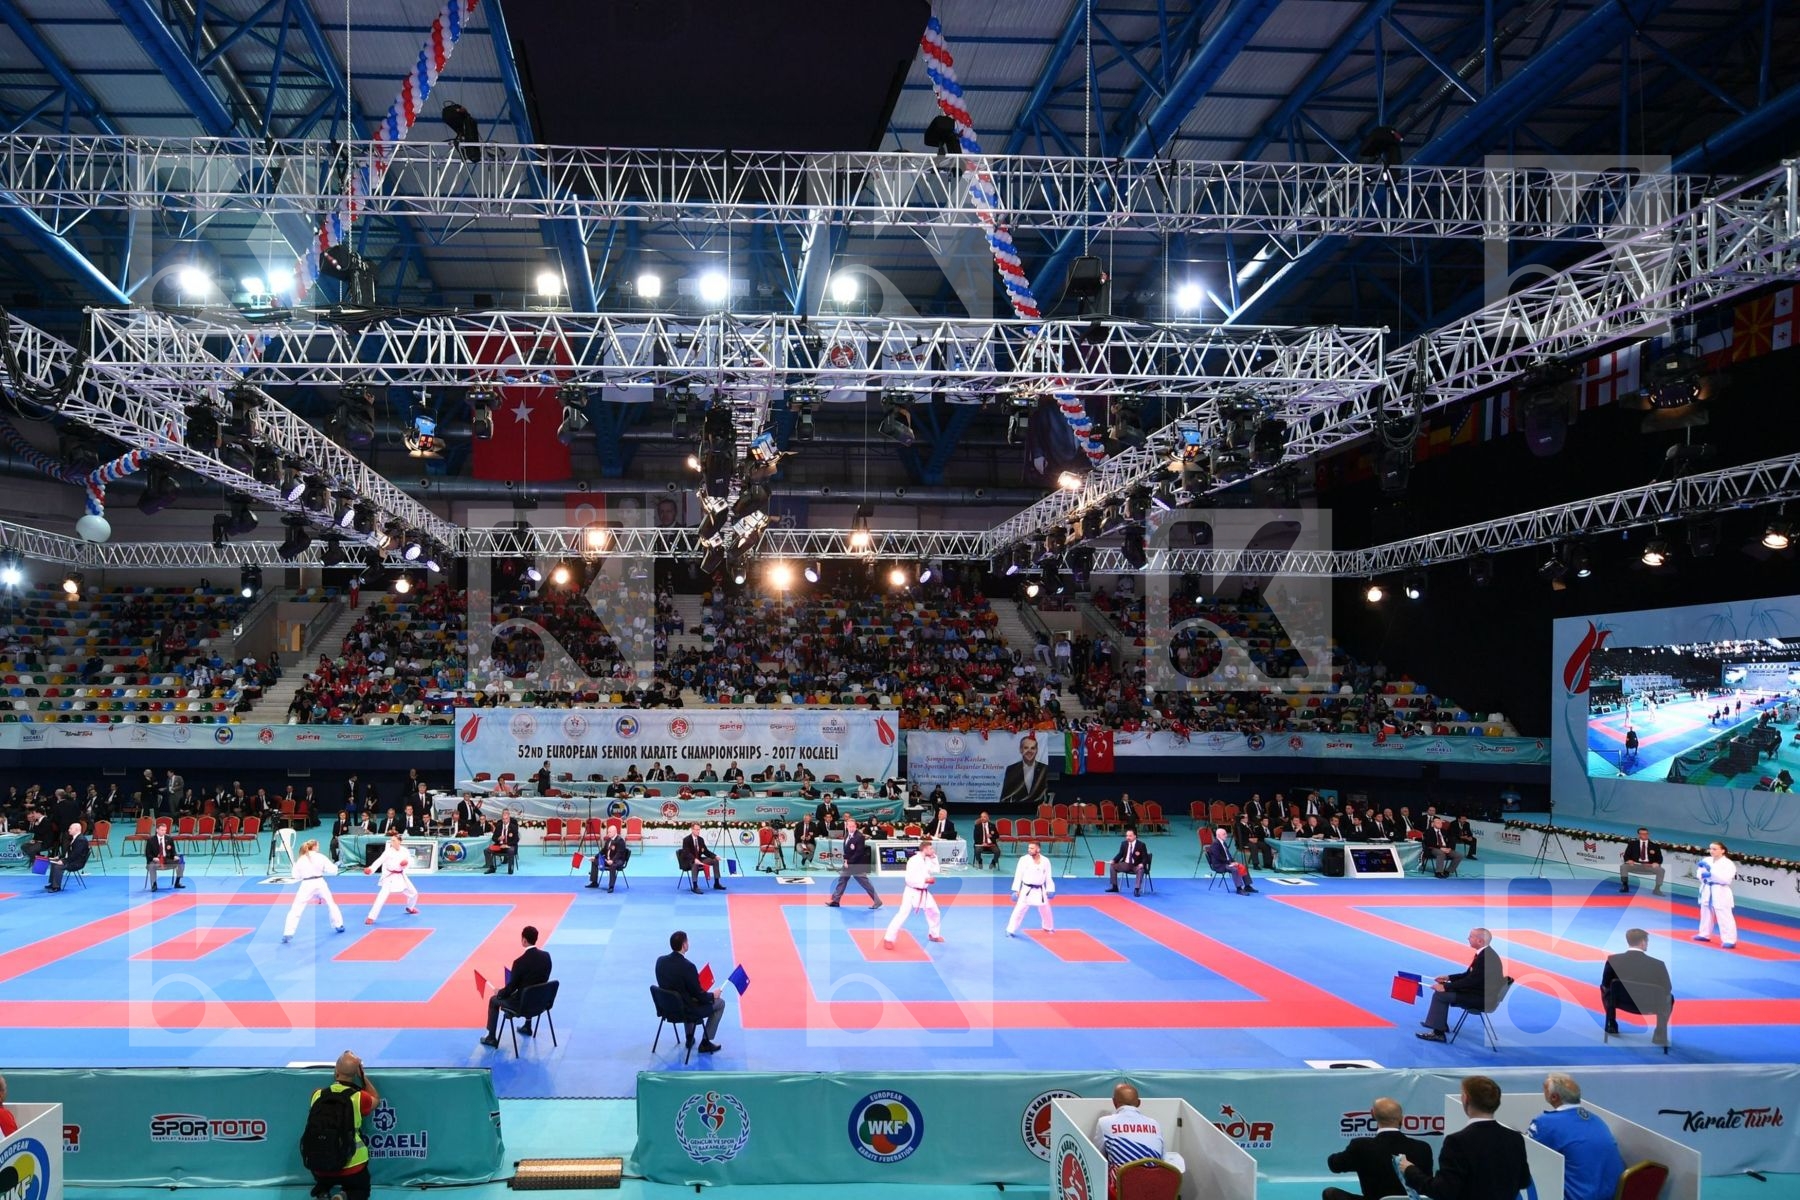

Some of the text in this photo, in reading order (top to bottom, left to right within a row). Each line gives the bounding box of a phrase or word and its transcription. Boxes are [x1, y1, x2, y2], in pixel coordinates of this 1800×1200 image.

[518, 745, 543, 758] 52ND
[546, 745, 598, 759] EUROPEAN
[601, 745, 637, 759] SENIOR
[641, 745, 678, 759] KARATE
[681, 745, 762, 760] CHAMPIONSHIPS
[772, 746, 795, 760] 2017
[799, 743, 839, 760] KOCAELİ
[869, 1091, 903, 1101] EUROPEAN
[1658, 1106, 1784, 1133] Karate Türk
[867, 1120, 903, 1135] WKF
[1111, 1124, 1157, 1134] SLOVAKIA
[389, 1149, 426, 1158] BELEDİYESİ
[857, 1146, 914, 1162] KARATE FEDERATION
